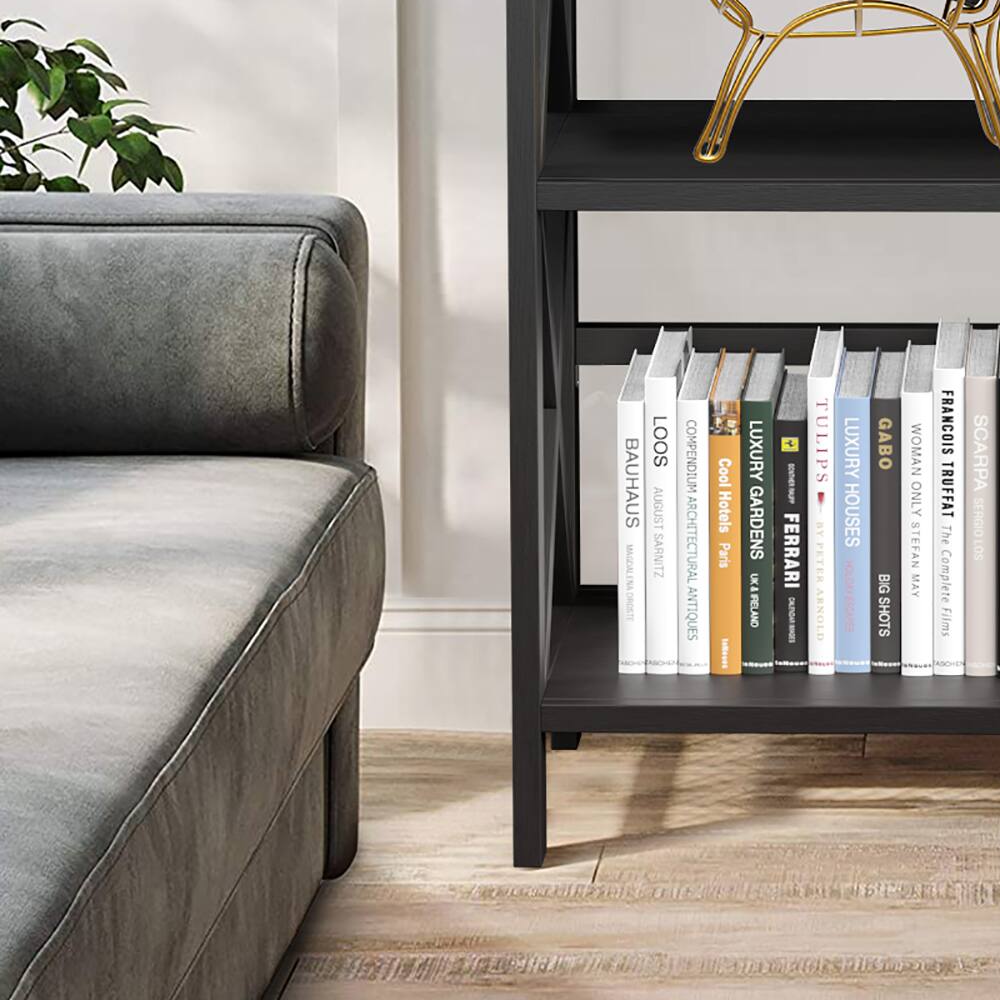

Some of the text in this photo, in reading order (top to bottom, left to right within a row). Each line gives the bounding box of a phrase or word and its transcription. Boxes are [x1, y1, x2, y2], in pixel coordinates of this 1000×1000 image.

[625, 438, 640, 528] BAUHAUS
[653, 416, 668, 467] LOOS
[815, 398, 828, 483] TULIPS
[844, 418, 860, 547] LUXURY HOUSES
[878, 418, 892, 470] GABO
[686, 420, 698, 641] COMPENDIUM ARCHITECTURAL ANTIQUES
[718, 458, 732, 532] Cool Hotels
[750, 421, 763, 559] LUXURY GARDENS
[911, 424, 922, 598] WOMAN ONLY STEFAN MAY
[938, 390, 954, 637] FRANCOIS TRUFFAT The Complete Films
[974, 415, 988, 561] SCARPA SERGIO LOS
[653, 487, 664, 578] AUGUST SARNITZ
[719, 543, 731, 568] Paris
[784, 513, 800, 588] FERRARI
[750, 573, 758, 584] UK
[751, 594, 759, 628] IRELAND
[816, 521, 825, 642] BY PETER ARNOLD
[878, 574, 891, 637] BIG SHOTS
